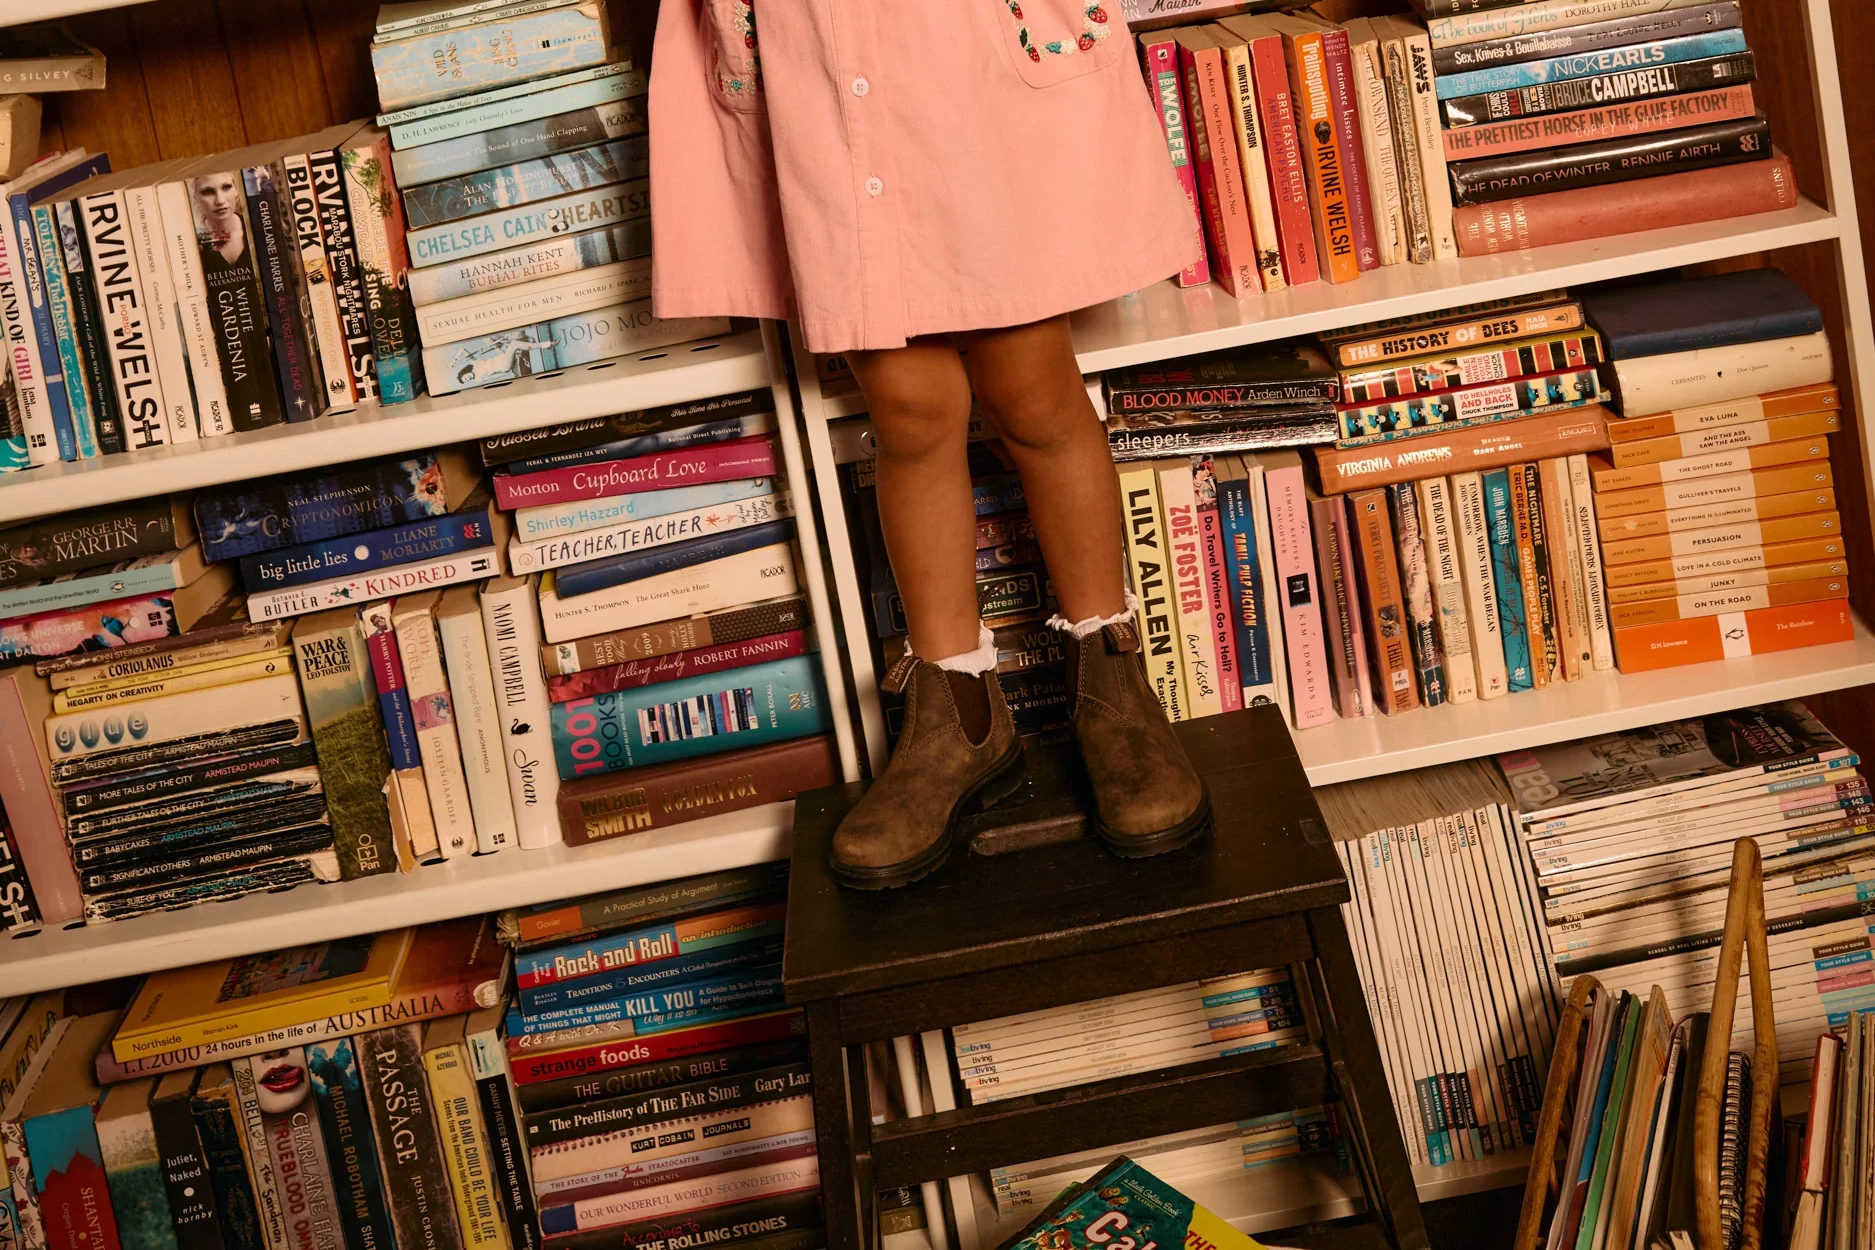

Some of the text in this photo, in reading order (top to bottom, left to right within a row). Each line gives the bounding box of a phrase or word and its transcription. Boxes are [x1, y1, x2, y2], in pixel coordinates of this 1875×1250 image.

[1565, 0, 1619, 19] DOROTHY
[1302, 39, 1328, 120] Trainspotting
[1410, 44, 1430, 94] JAWS
[1335, 62, 1347, 106] intimate
[1555, 67, 1674, 106] BRUCE CAMPBELL
[1160, 85, 1186, 166] WOLFE
[1474, 94, 1728, 147] PRETTIEST HORSE FACTORY
[285, 166, 322, 250] BLOCK
[1316, 145, 1351, 257] IRVINE WELSH
[416, 215, 548, 258] CHELSEA CAIN
[459, 247, 563, 279] HANNAH KENT
[467, 260, 560, 289] BURIAL RITES
[120, 304, 132, 335] PORNO
[235, 287, 254, 332] WHITE
[218, 290, 247, 383] GARDENIA
[1348, 319, 1518, 361] THE HISTORY OF BEES
[1122, 384, 1320, 409] BLOOD MONEY Arden Winch
[1699, 411, 1739, 424] EVA LUNA
[1116, 429, 1191, 453] sleepers
[508, 457, 707, 498] Morton Cupboard Love
[526, 501, 635, 534] Shirley Hazzard
[55, 530, 138, 562] MARTIN
[1692, 533, 1741, 546] PERSUASION
[259, 552, 348, 580] big little lies
[364, 563, 457, 596] KINDRED
[760, 565, 786, 578] PICADOR
[1127, 488, 1172, 657] LILY ALLEN
[1174, 549, 1204, 615] FOSTER
[1710, 578, 1736, 588] JUNKY
[263, 596, 319, 618] BUTLER
[1694, 595, 1751, 609] ON THE ROAD
[301, 640, 333, 656] WAR
[303, 650, 350, 670] PEACE
[492, 603, 527, 707] NAOMI CAMPBELL
[693, 639, 789, 667] ROBERT FANNIN
[108, 655, 175, 678] CORIOLANUS
[322, 663, 350, 678] TOLSTOY
[66, 683, 165, 708] HEGARTY CREATIVITY
[600, 695, 625, 772] BOOKS
[204, 757, 279, 780] ARMISTEAD MAUPIN
[1838, 758, 1851, 768] 107
[1847, 780, 1861, 789] 135
[586, 810, 652, 839] SMITH
[360, 859, 379, 871] Pan
[554, 932, 672, 978] Rock and Roll
[323, 993, 447, 1035] AUSTRALIA
[625, 990, 694, 1017] KILL YOU
[132, 1035, 182, 1053] Northside
[530, 1045, 650, 1077] strange foods
[690, 1059, 728, 1077] BIBLE
[376, 1049, 418, 1166] PASSAGE
[573, 1107, 634, 1130] PreHistory
[659, 1131, 693, 1146] COBAIN
[704, 1119, 749, 1136] JOURNALS
[167, 1153, 198, 1169] Juliet,
[169, 1168, 202, 1183] Naked
[732, 1217, 787, 1238] STONES
